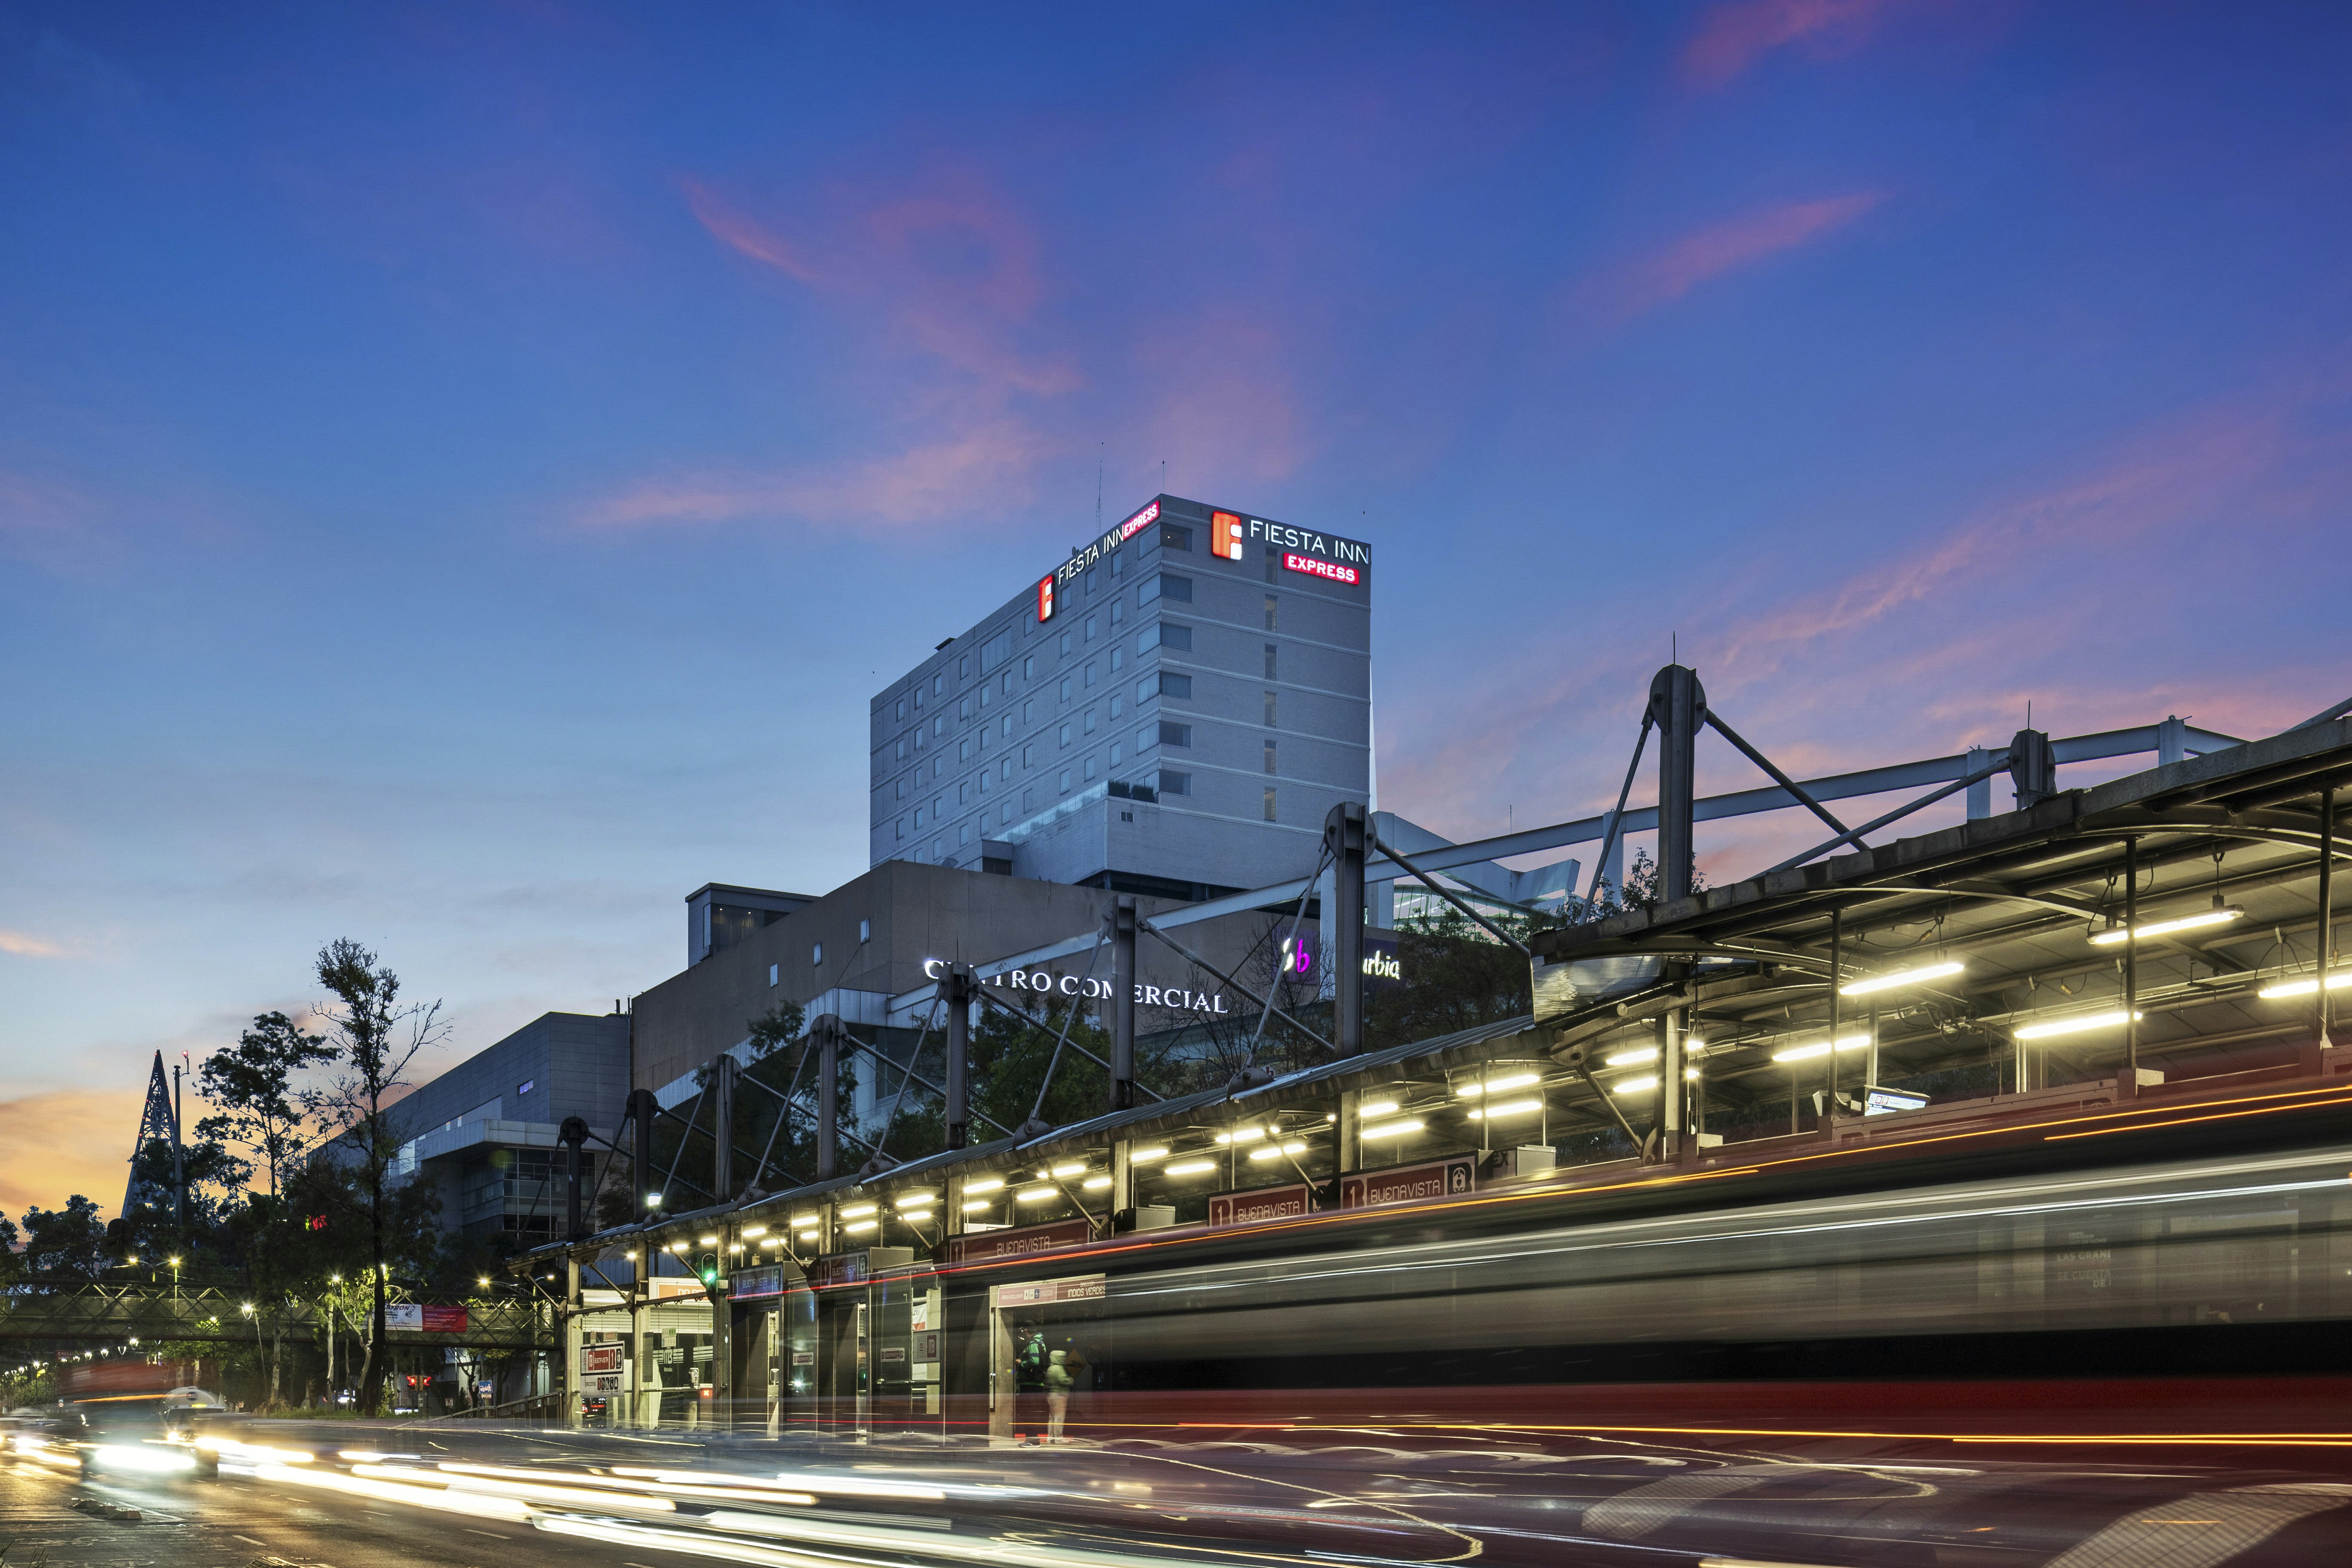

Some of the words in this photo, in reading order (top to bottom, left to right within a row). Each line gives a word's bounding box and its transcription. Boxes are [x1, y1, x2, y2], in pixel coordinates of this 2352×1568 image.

[1058, 544, 1099, 585] FIESTA
[1103, 524, 1124, 554] INN
[1124, 504, 1158, 537] EXPRESS
[1250, 519, 1326, 555] FIESTA
[1335, 540, 1369, 564] INN
[1288, 555, 1356, 582] EXPRESS
[1370, 1179, 1440, 1204] BUENAVISTA
[1237, 1200, 1300, 1222] BUENAVISTA
[996, 1236, 1050, 1256] BUENAVISTA
[832, 1265, 856, 1276] BUENAVISTA
[742, 1277, 768, 1289] BUENAVISTA
[1068, 1288, 1084, 1297] INDIOS
[1085, 1286, 1106, 1295] VERDES
